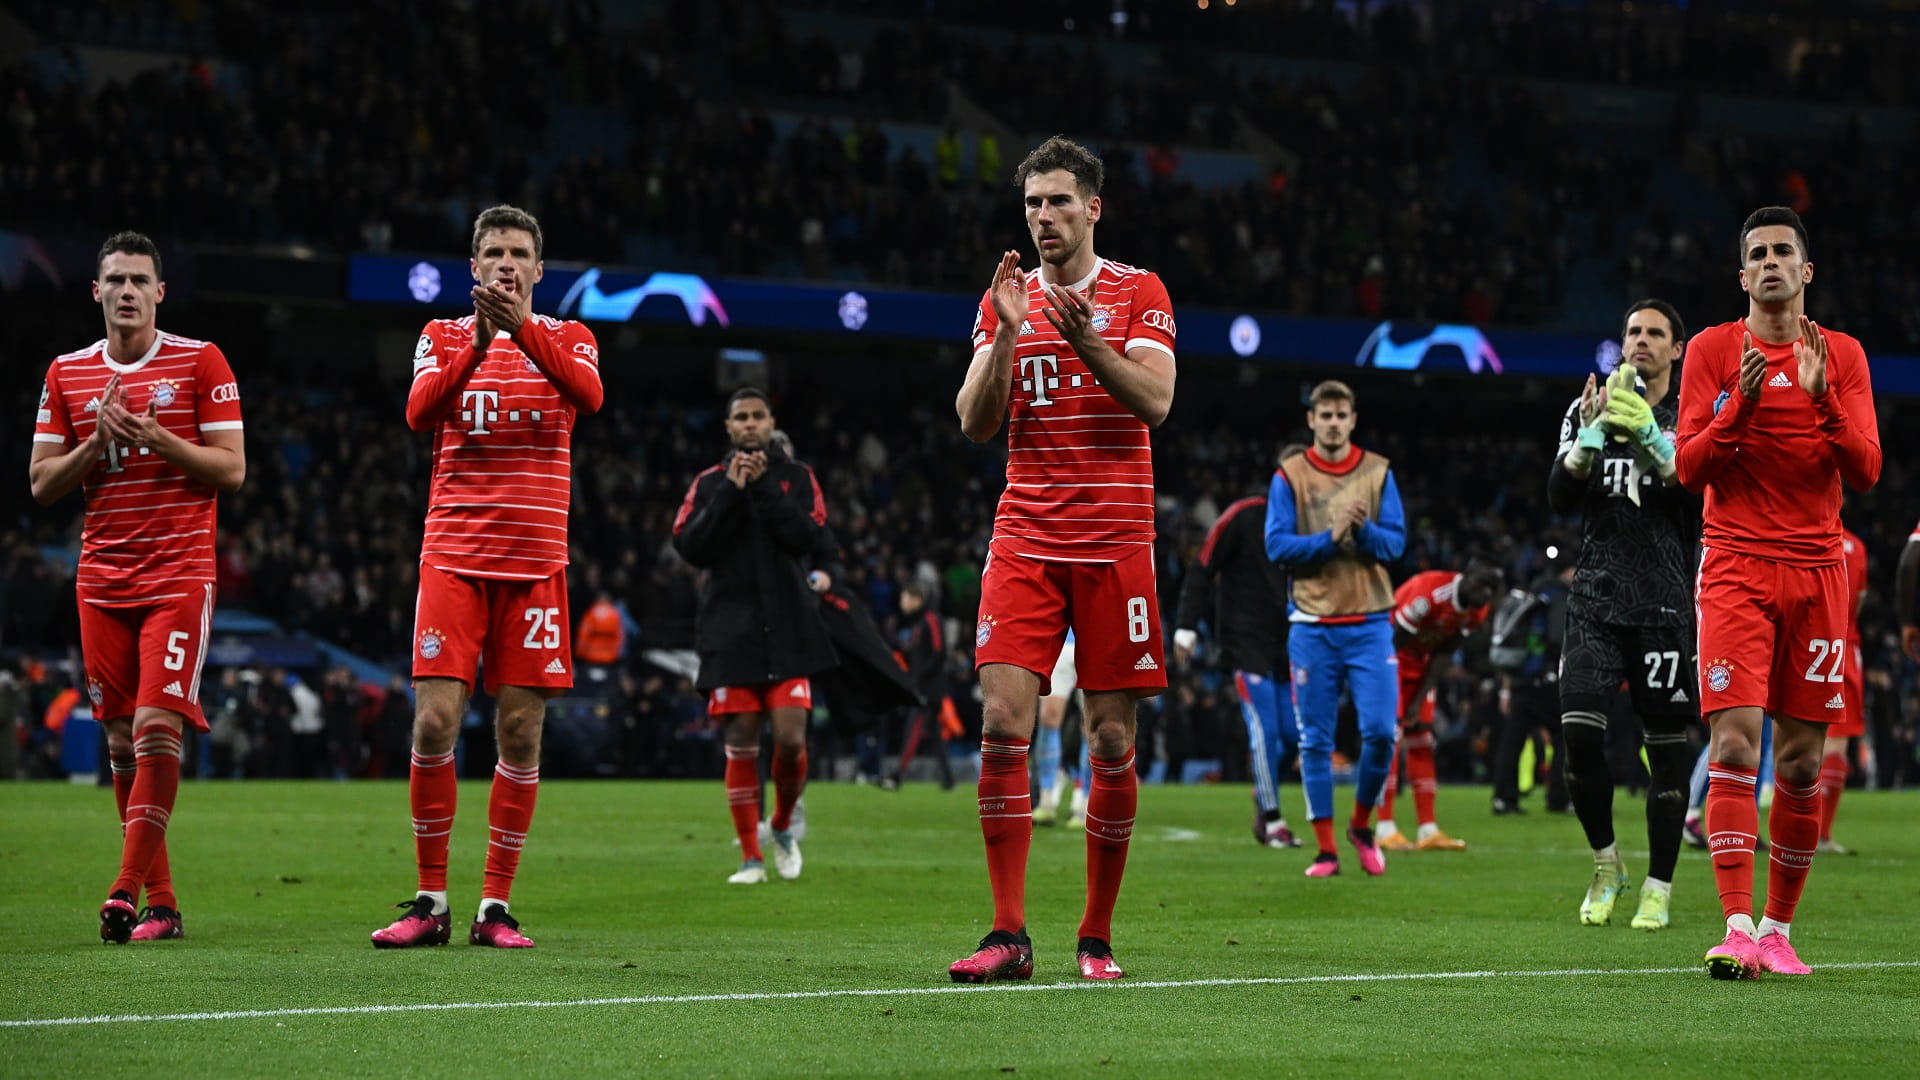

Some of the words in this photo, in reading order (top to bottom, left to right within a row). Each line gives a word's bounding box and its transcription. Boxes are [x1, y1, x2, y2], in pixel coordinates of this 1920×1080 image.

[1020, 355, 1058, 407] T
[461, 390, 499, 435] T
[523, 608, 560, 649] 25
[1127, 596, 1150, 642] 8
[164, 630, 189, 671] 5
[1644, 651, 1680, 688] 27
[1804, 639, 1844, 682] 22
[1711, 838, 1744, 848] BAYERN
